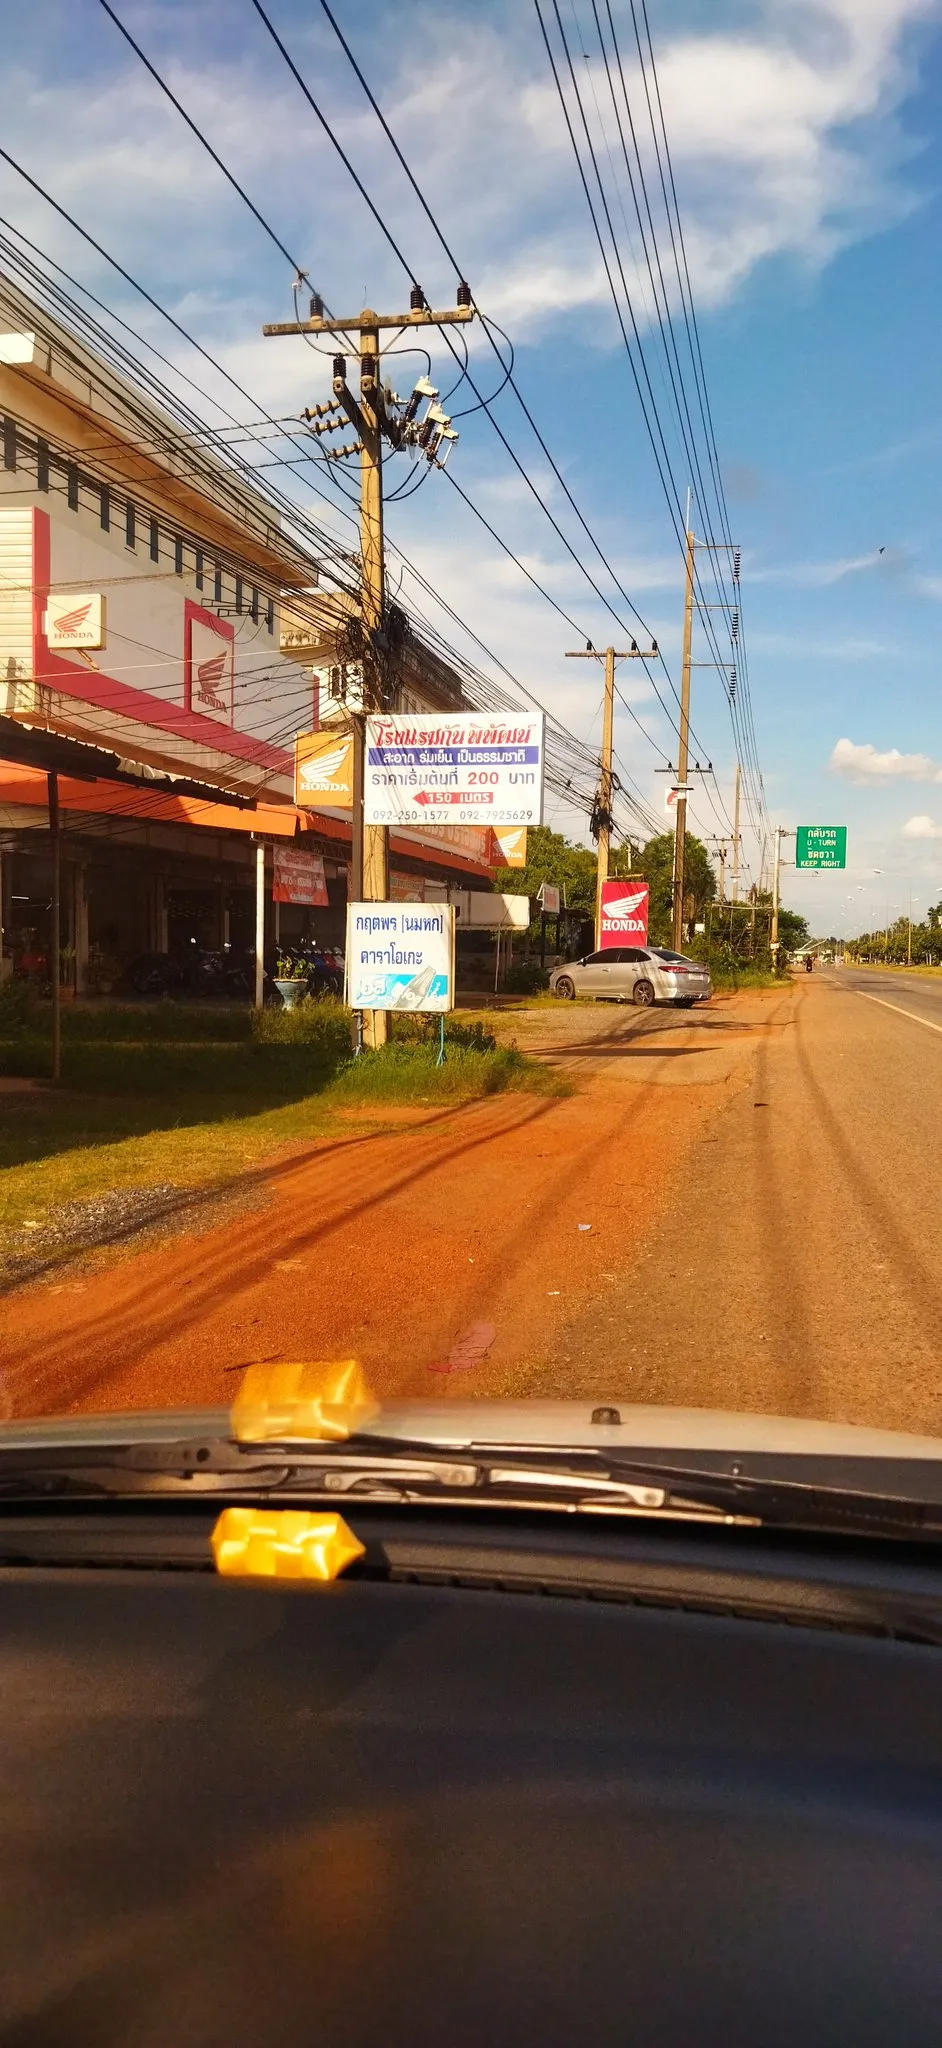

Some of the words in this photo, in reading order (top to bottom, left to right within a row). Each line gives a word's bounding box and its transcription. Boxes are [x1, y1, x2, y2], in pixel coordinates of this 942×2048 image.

[54, 632, 94, 640] HONDA
[197, 691, 228, 713] HONDA
[383, 752, 415, 765] สะอาด
[419, 749, 453, 763] ร่มเย็น
[457, 748, 526, 763] เป็นธรรมชาติ
[371, 768, 458, 786] ราคาเริ่มต้นที่
[467, 772, 499, 785] 200
[509, 773, 535, 785] บาท
[299, 782, 350, 792] HONDA
[428, 792, 453, 803] 150
[459, 792, 490, 803] เมตร
[373, 810, 449, 820] 092-250-1577
[460, 810, 533, 820] 092-7925629
[808, 828, 836, 838] กลับรถ
[808, 847, 834, 858] ชิดขวา
[356, 916, 397, 935] กฤตพร
[602, 919, 645, 931] HONDA
